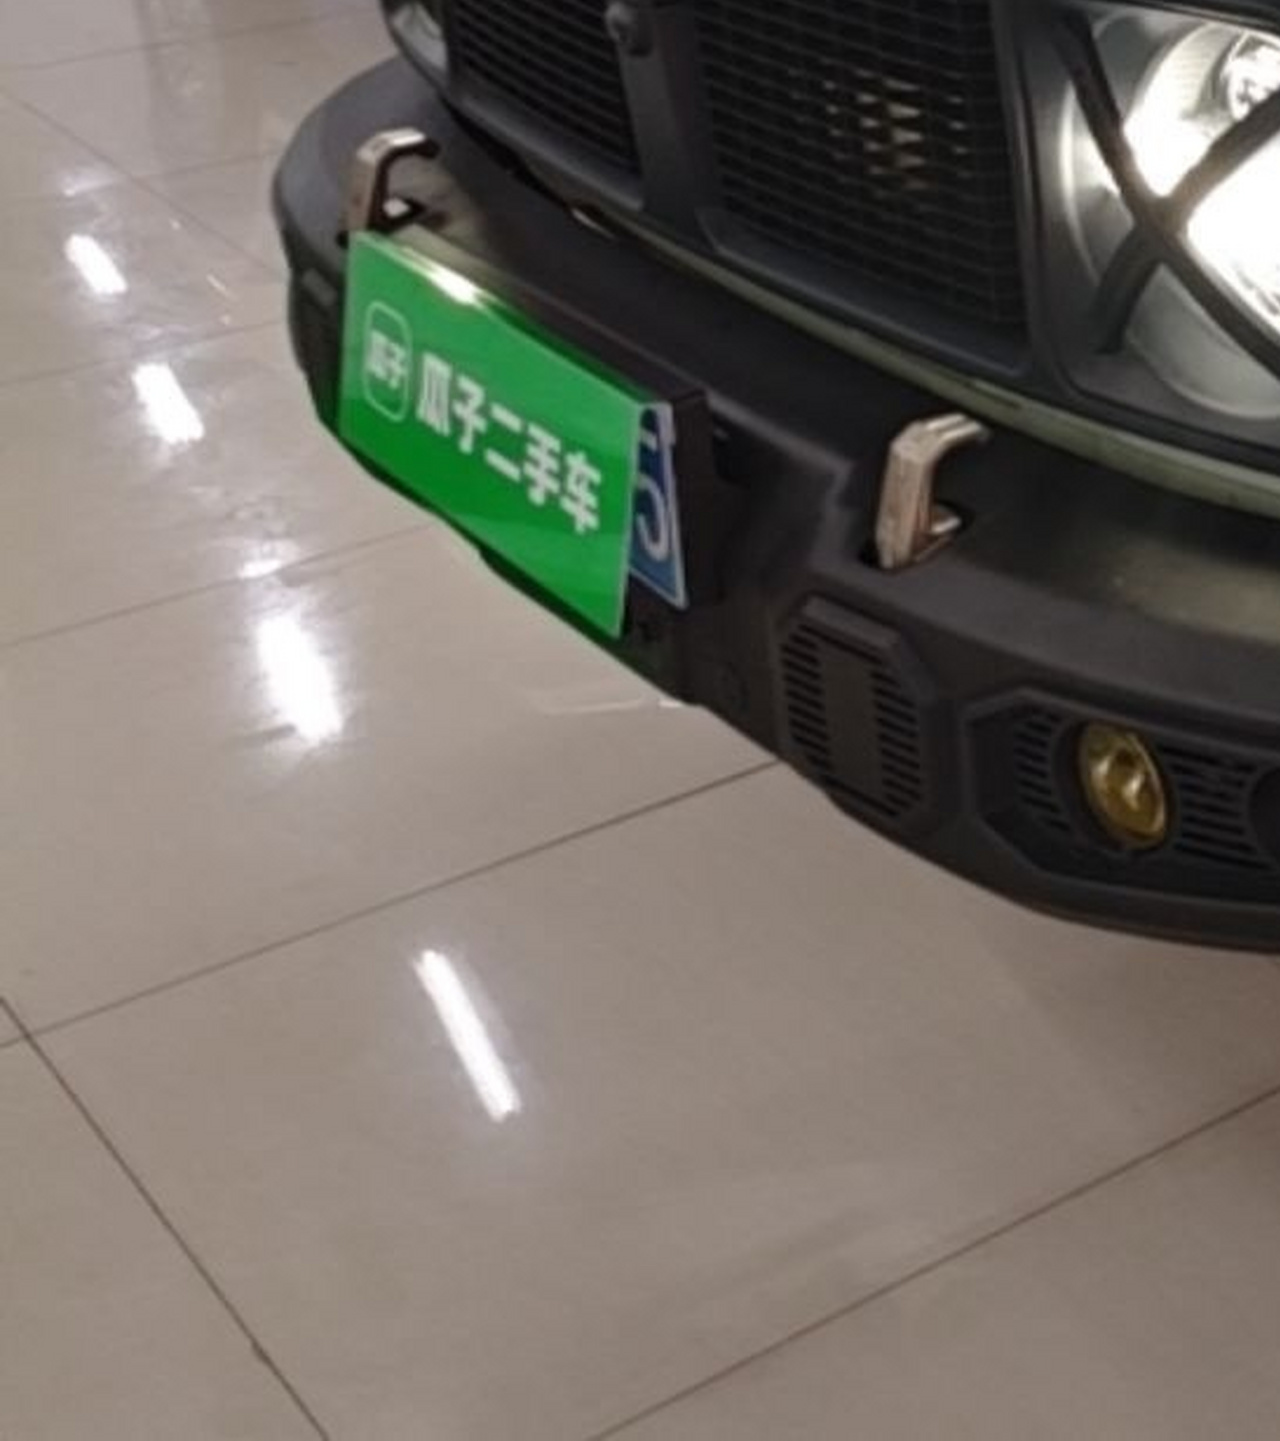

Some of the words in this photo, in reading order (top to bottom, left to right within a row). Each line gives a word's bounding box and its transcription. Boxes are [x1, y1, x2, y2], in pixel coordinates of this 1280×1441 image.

[415, 351, 602, 535] 瓜子二手车
